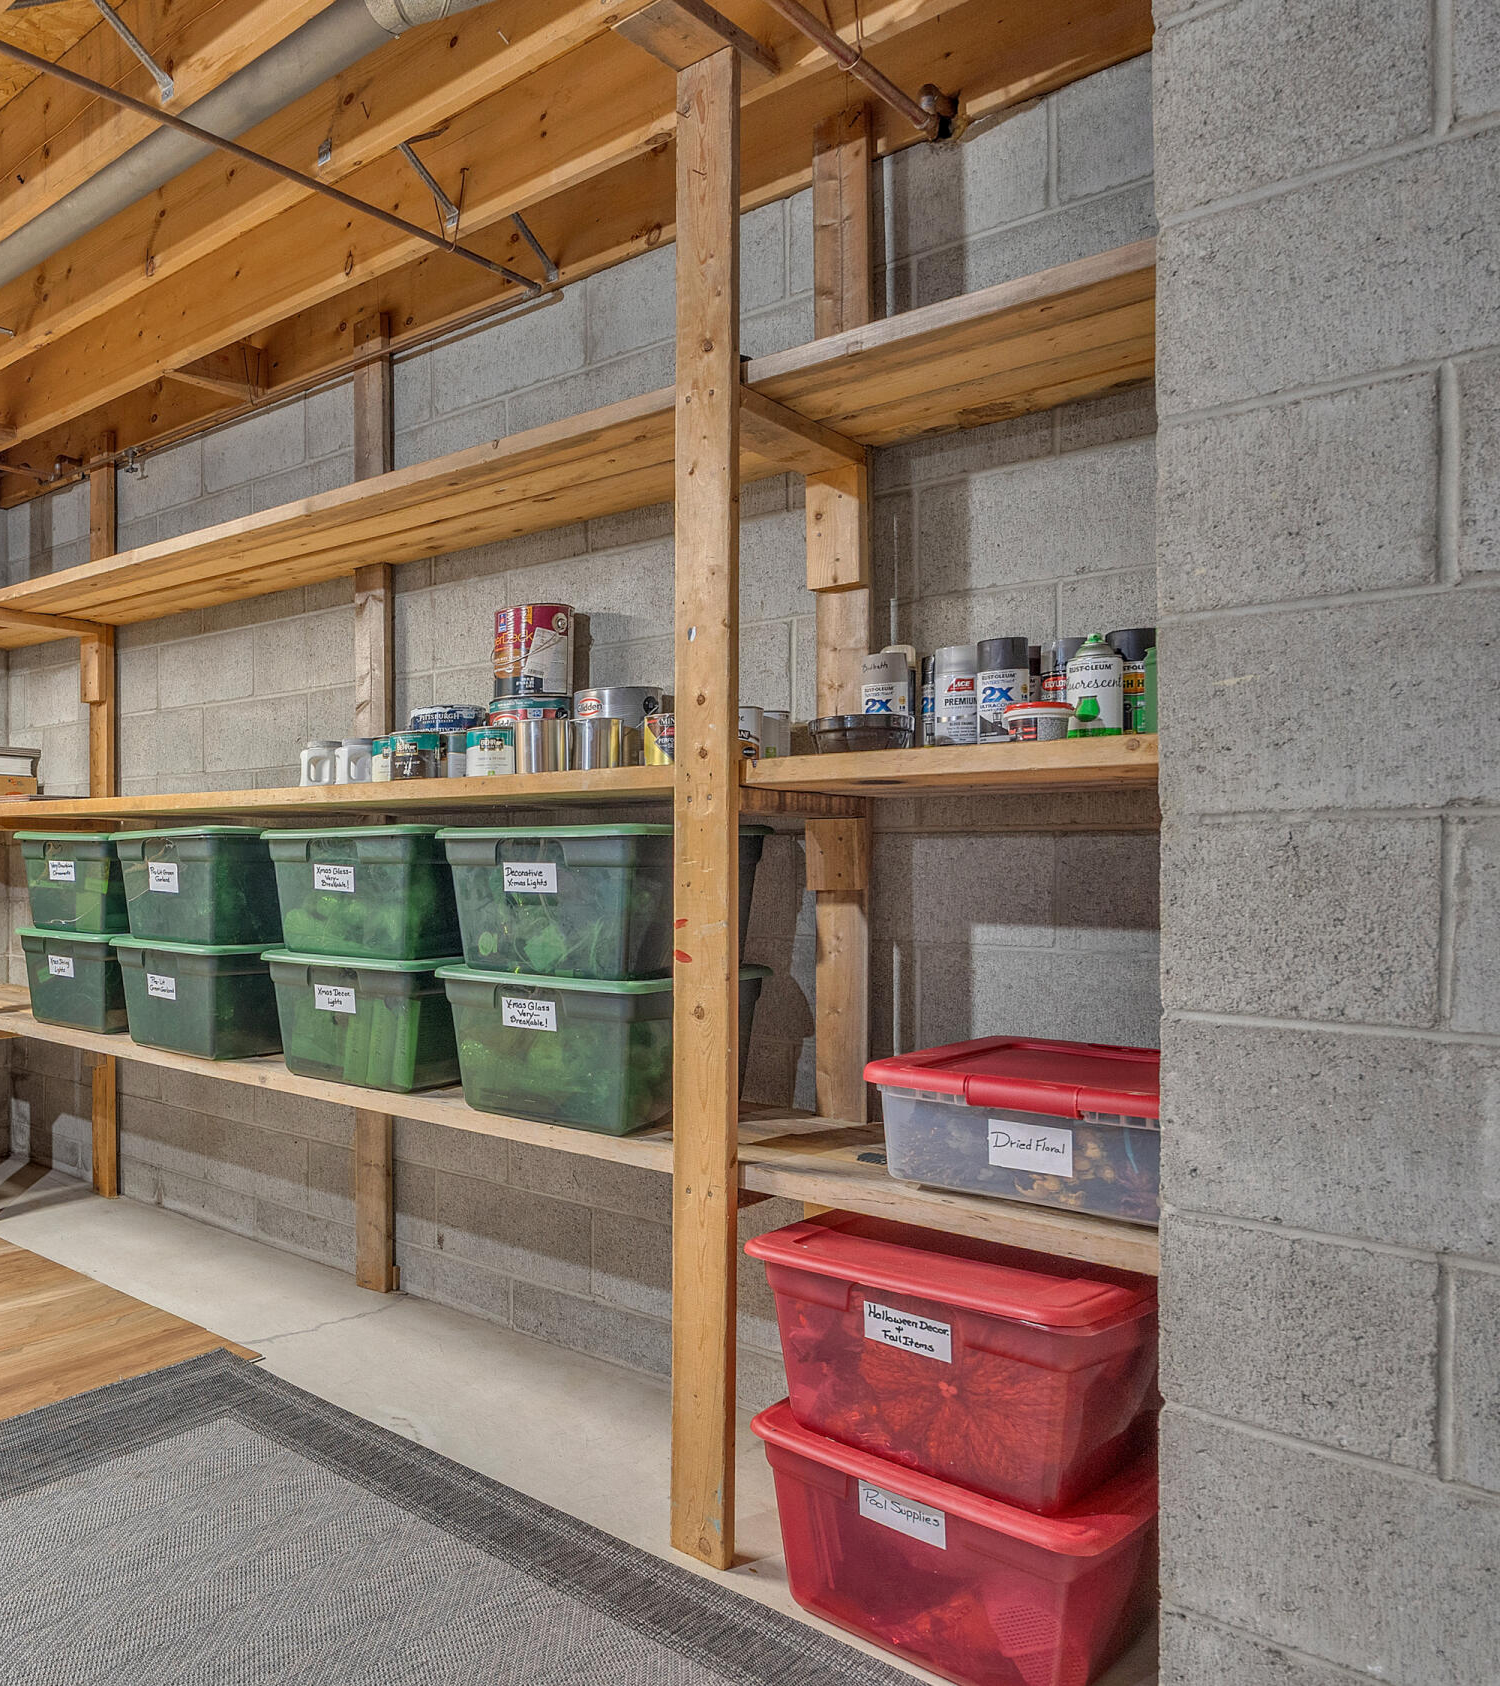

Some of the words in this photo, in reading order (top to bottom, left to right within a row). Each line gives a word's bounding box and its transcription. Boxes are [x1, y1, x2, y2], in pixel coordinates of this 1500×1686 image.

[982, 686, 1014, 703] 2X
[577, 703, 603, 712] Glidden
[865, 698, 893, 714] 2X
[660, 717, 675, 725] MIN
[504, 866, 543, 877] Decorative
[527, 878, 548, 889] Lights
[528, 1001, 550, 1011] Glass
[990, 1131, 1033, 1150] Dried
[1035, 1137, 1066, 1154] Floral
[868, 1303, 918, 1329] Halloween
[881, 1329, 902, 1343] Fall
[902, 1336, 935, 1352] Items
[862, 1488, 887, 1510] Pool
[890, 1500, 940, 1527] Supplies
